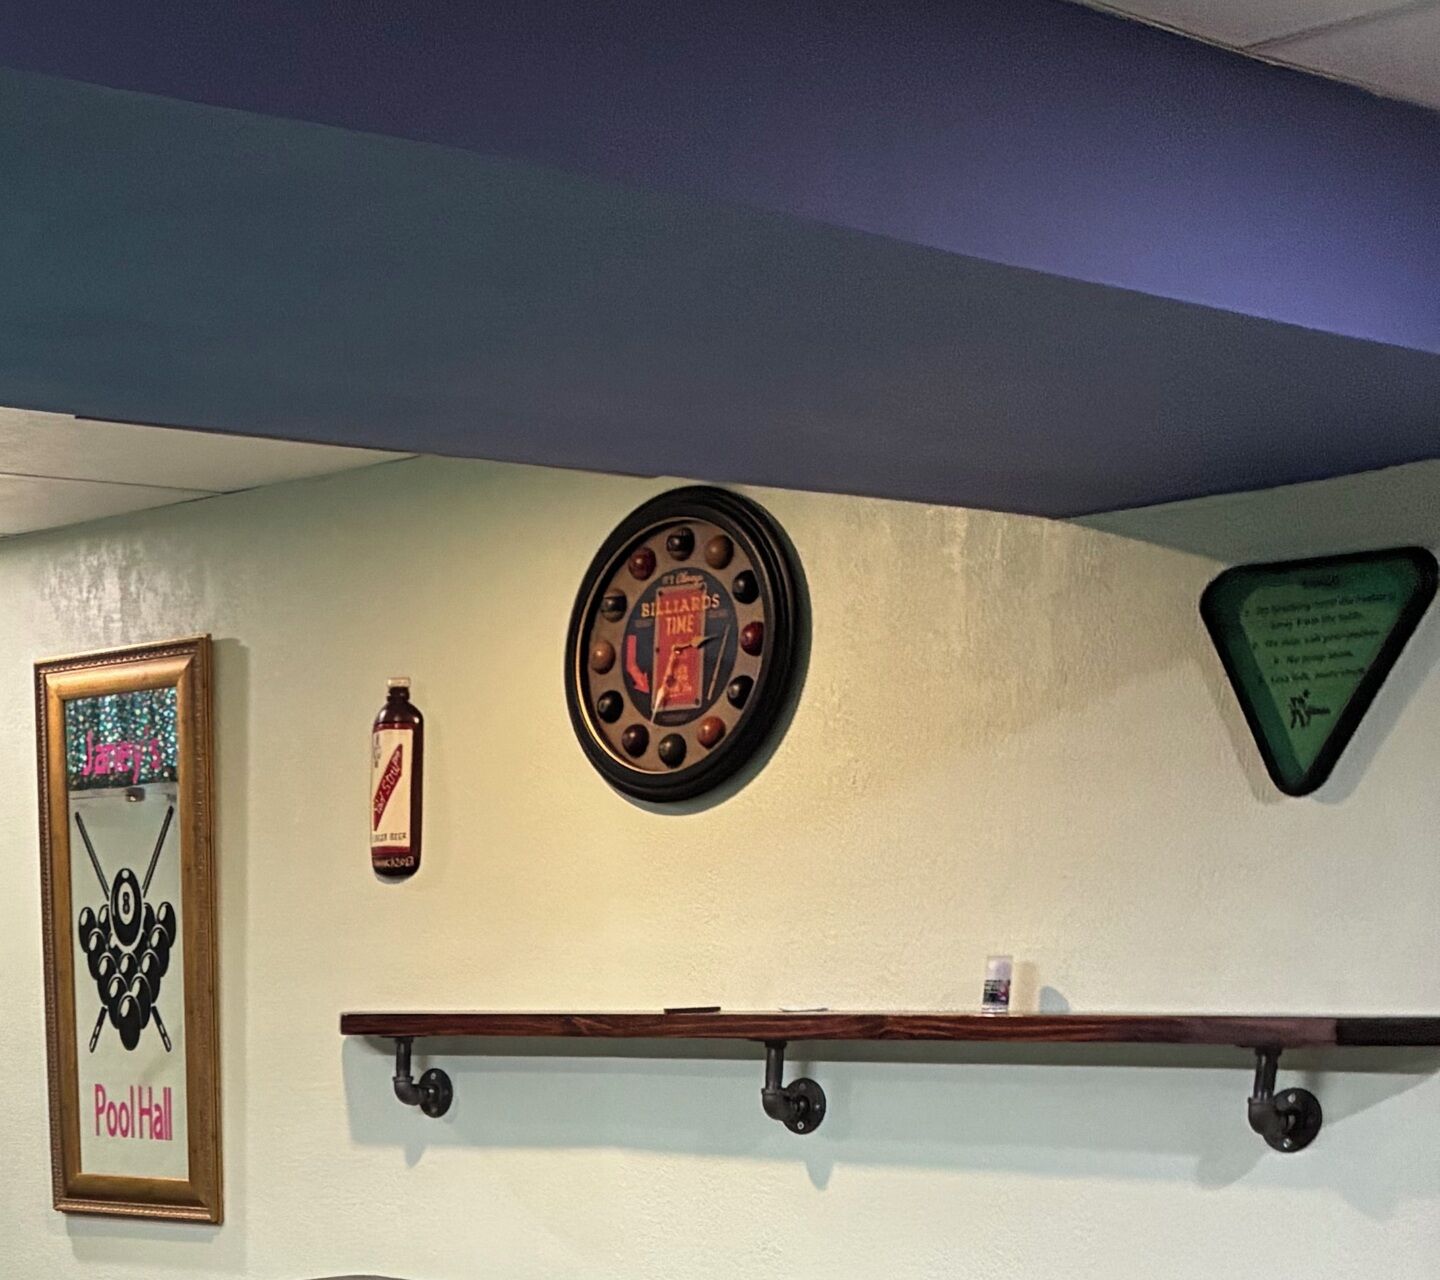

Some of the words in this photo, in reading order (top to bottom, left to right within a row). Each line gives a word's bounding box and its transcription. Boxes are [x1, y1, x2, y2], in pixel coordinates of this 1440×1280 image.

[641, 593, 720, 617] BILLIARDS
[665, 614, 694, 636] TIME
[122, 891, 130, 915] 8
[94, 1083, 135, 1139] Pool
[138, 1085, 173, 1141] Hall
